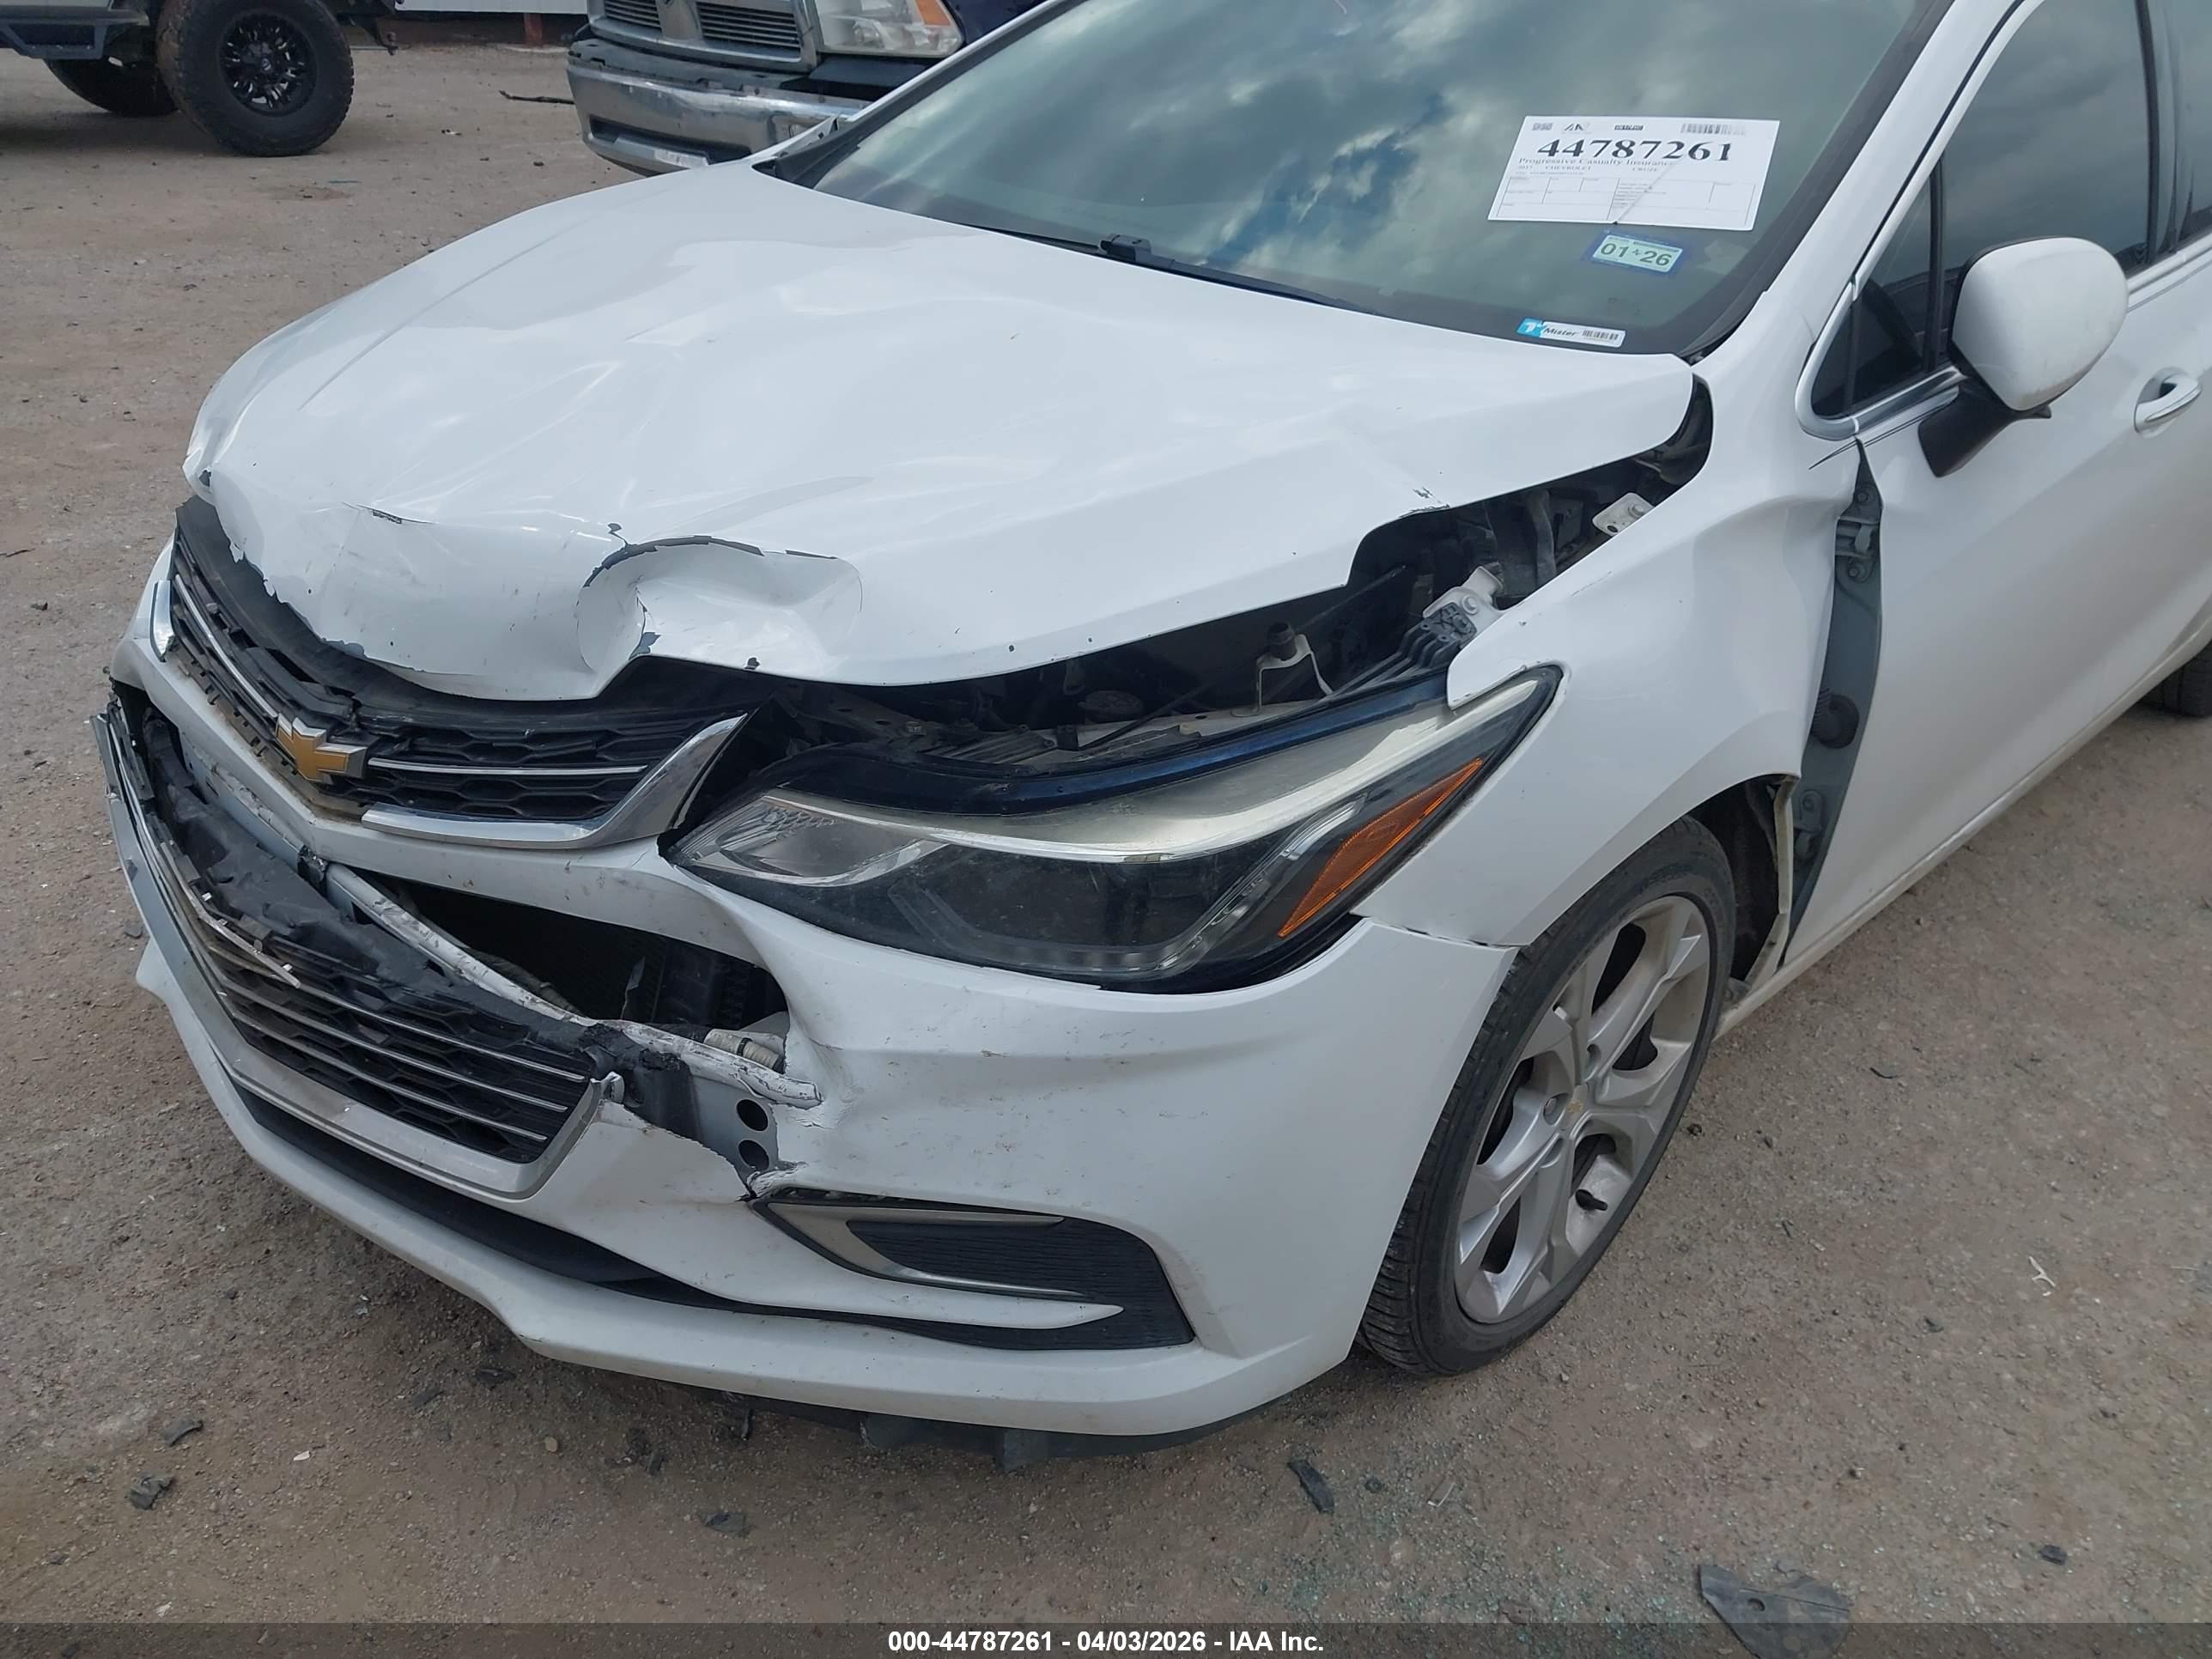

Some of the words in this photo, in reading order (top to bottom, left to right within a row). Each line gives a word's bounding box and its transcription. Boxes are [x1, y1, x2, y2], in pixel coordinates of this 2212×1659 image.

[1537, 138, 1732, 161] 44787261
[1518, 157, 1577, 166] Progressive
[1579, 158, 1621, 167] Casualty
[1601, 242, 1629, 258] 01
[1639, 250, 1672, 266] 26
[1543, 326, 1577, 337] Mister
